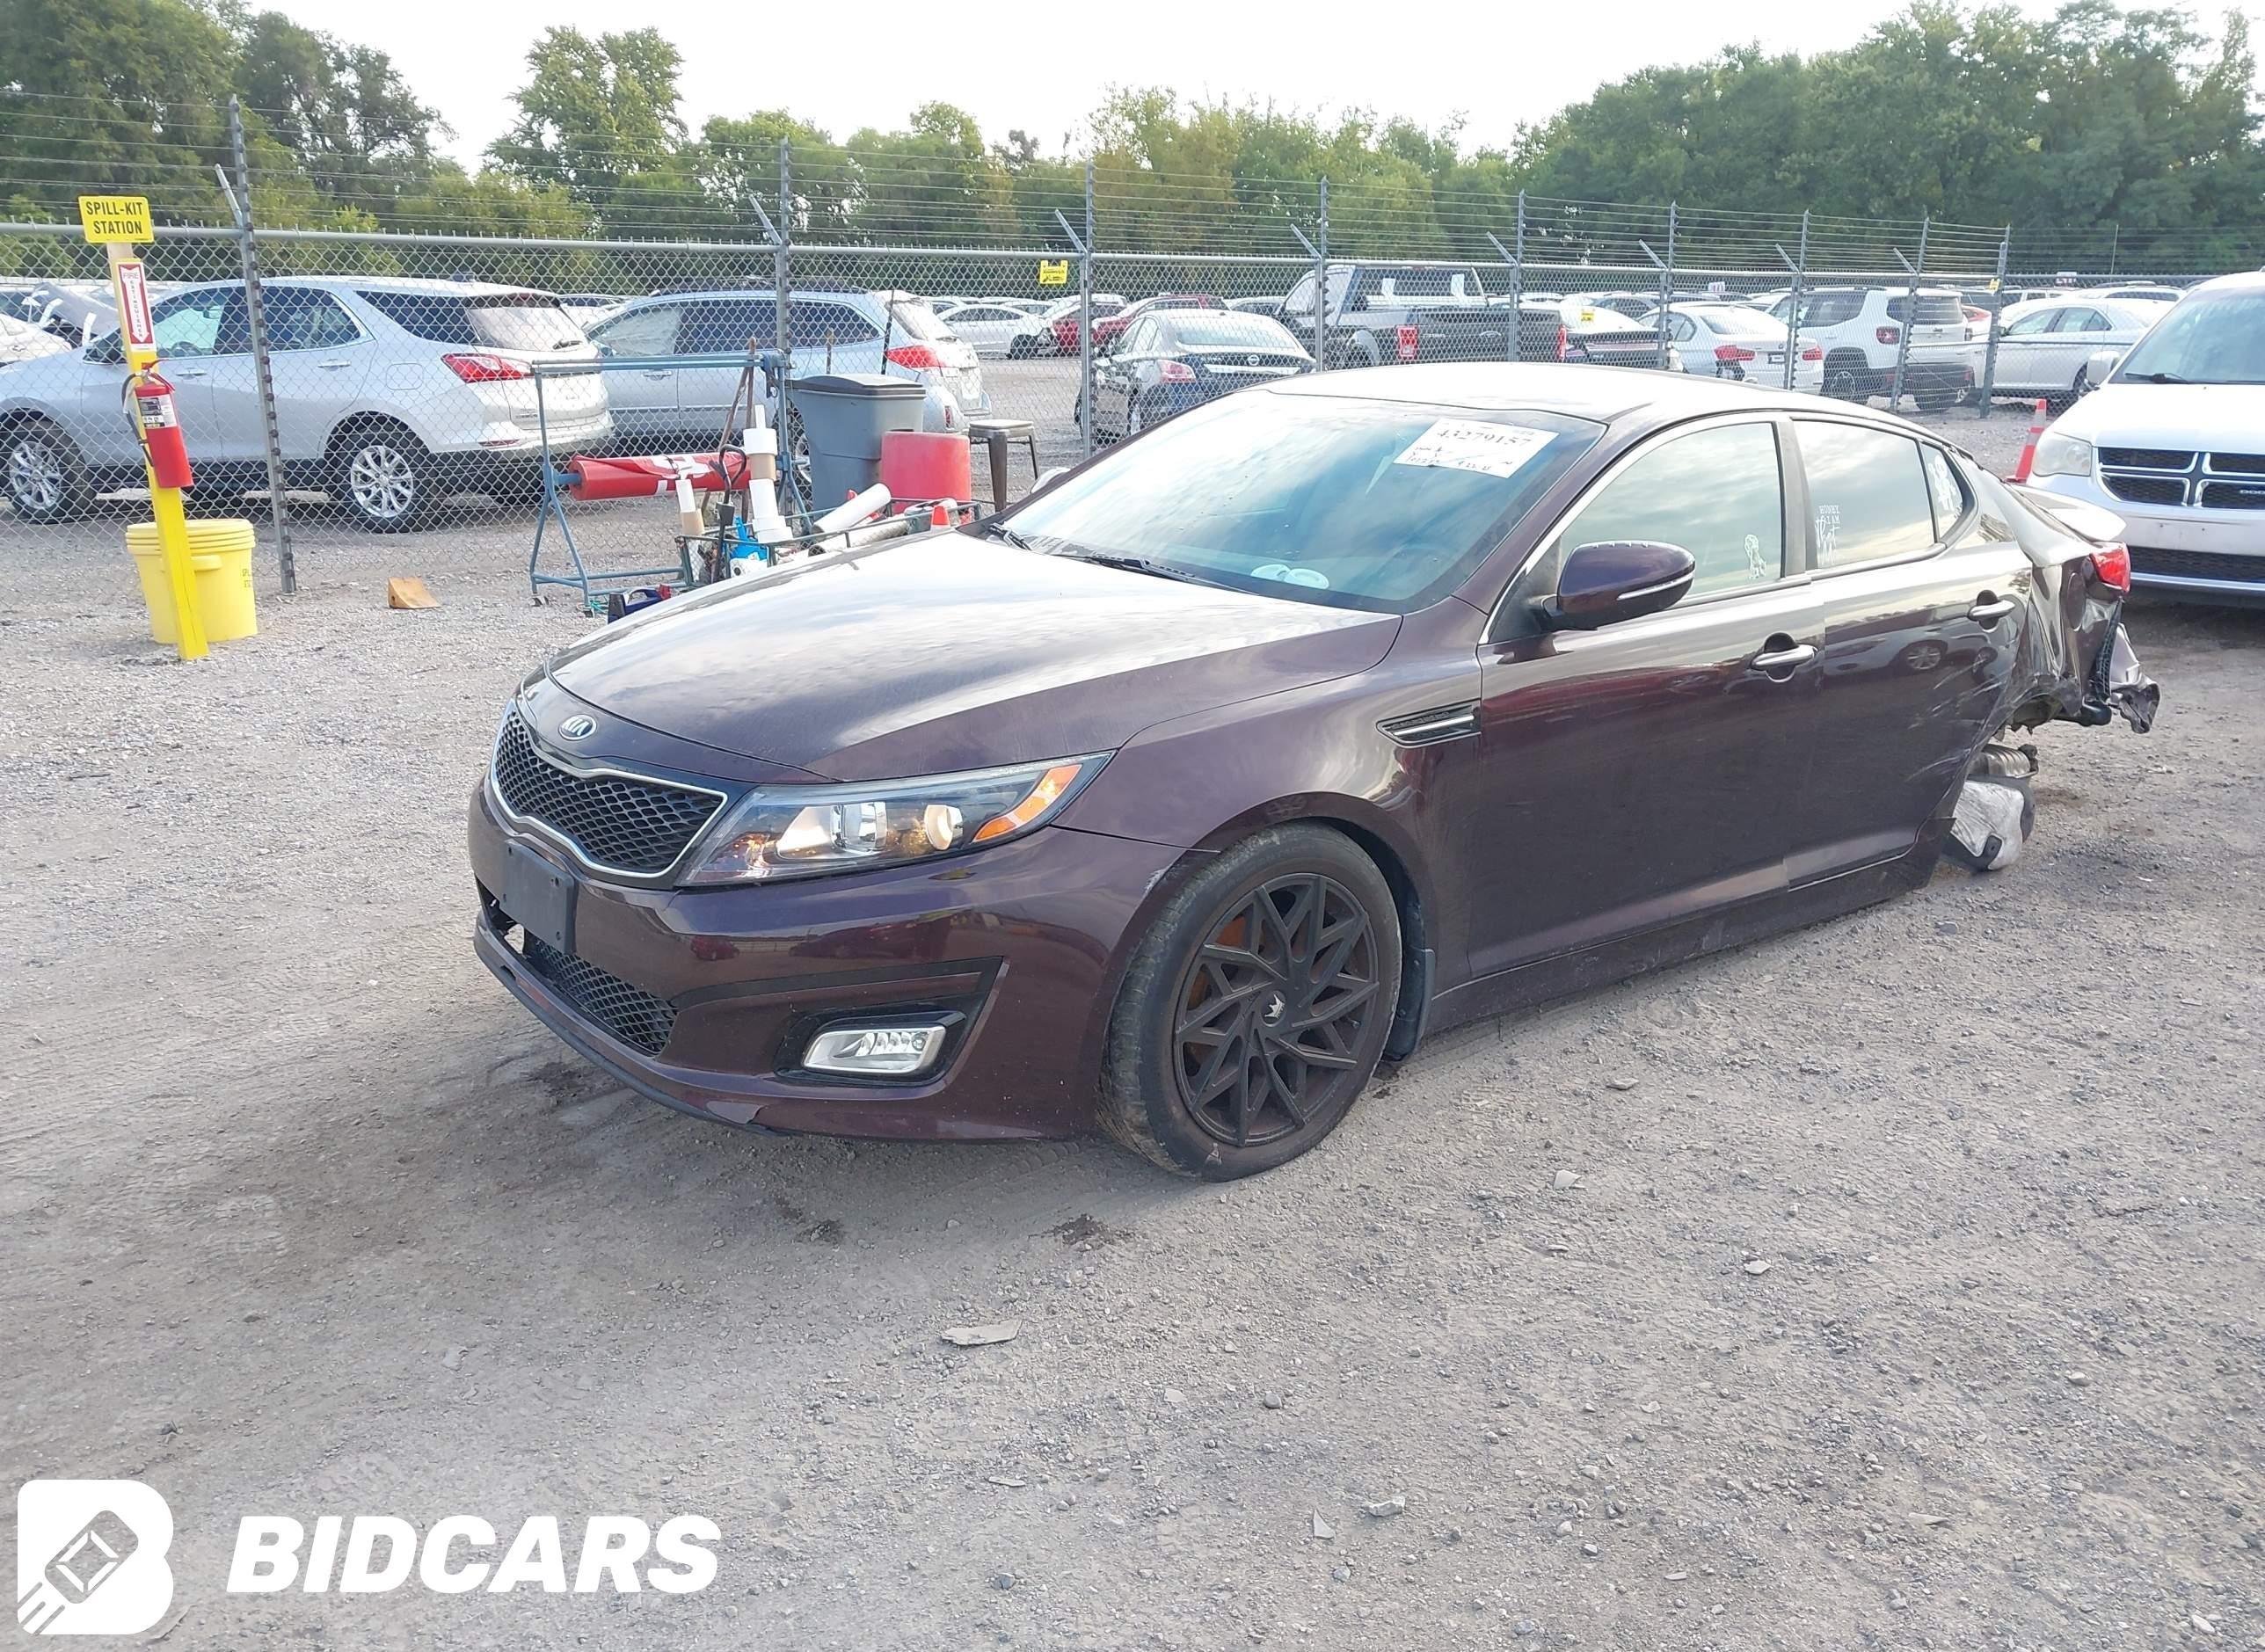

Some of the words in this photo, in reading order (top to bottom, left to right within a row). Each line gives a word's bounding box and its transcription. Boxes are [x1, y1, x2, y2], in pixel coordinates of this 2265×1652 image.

[85, 200, 142, 215] SPILL-KIT
[93, 220, 143, 234] STATION
[561, 716, 590, 737] KIA
